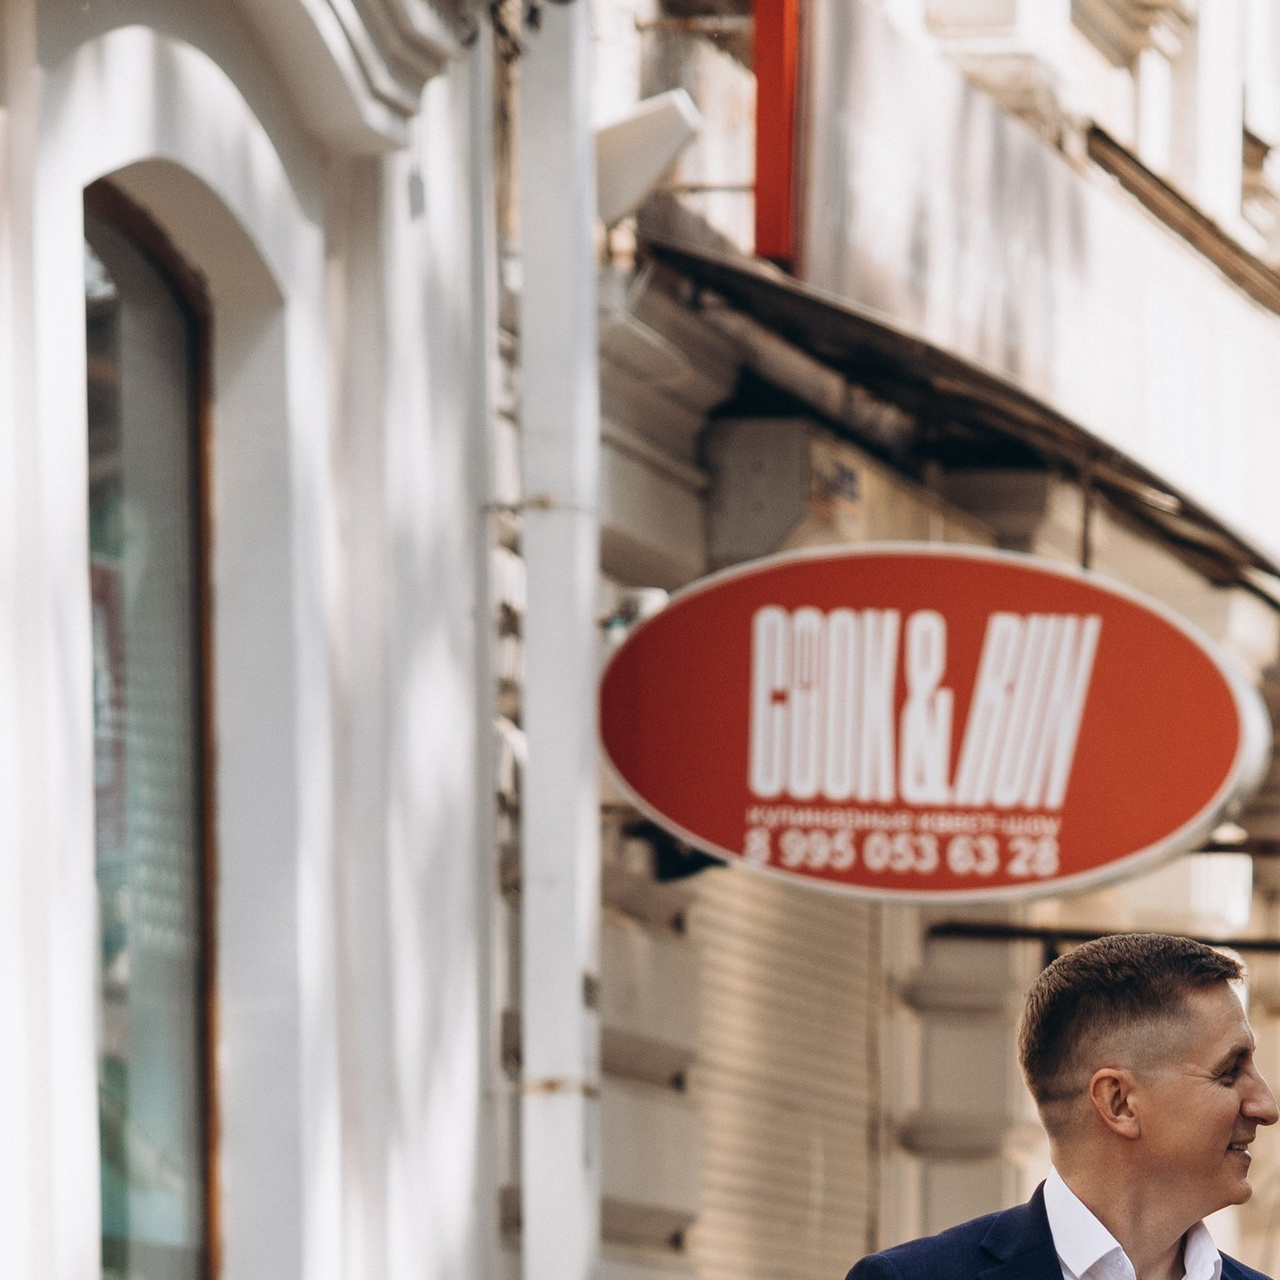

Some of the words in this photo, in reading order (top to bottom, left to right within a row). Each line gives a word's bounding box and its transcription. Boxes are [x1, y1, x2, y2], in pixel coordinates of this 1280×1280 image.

[780, 829, 855, 868] 995
[863, 831, 938, 873] 053
[948, 834, 999, 876] 63
[1008, 836, 1060, 877] 28
